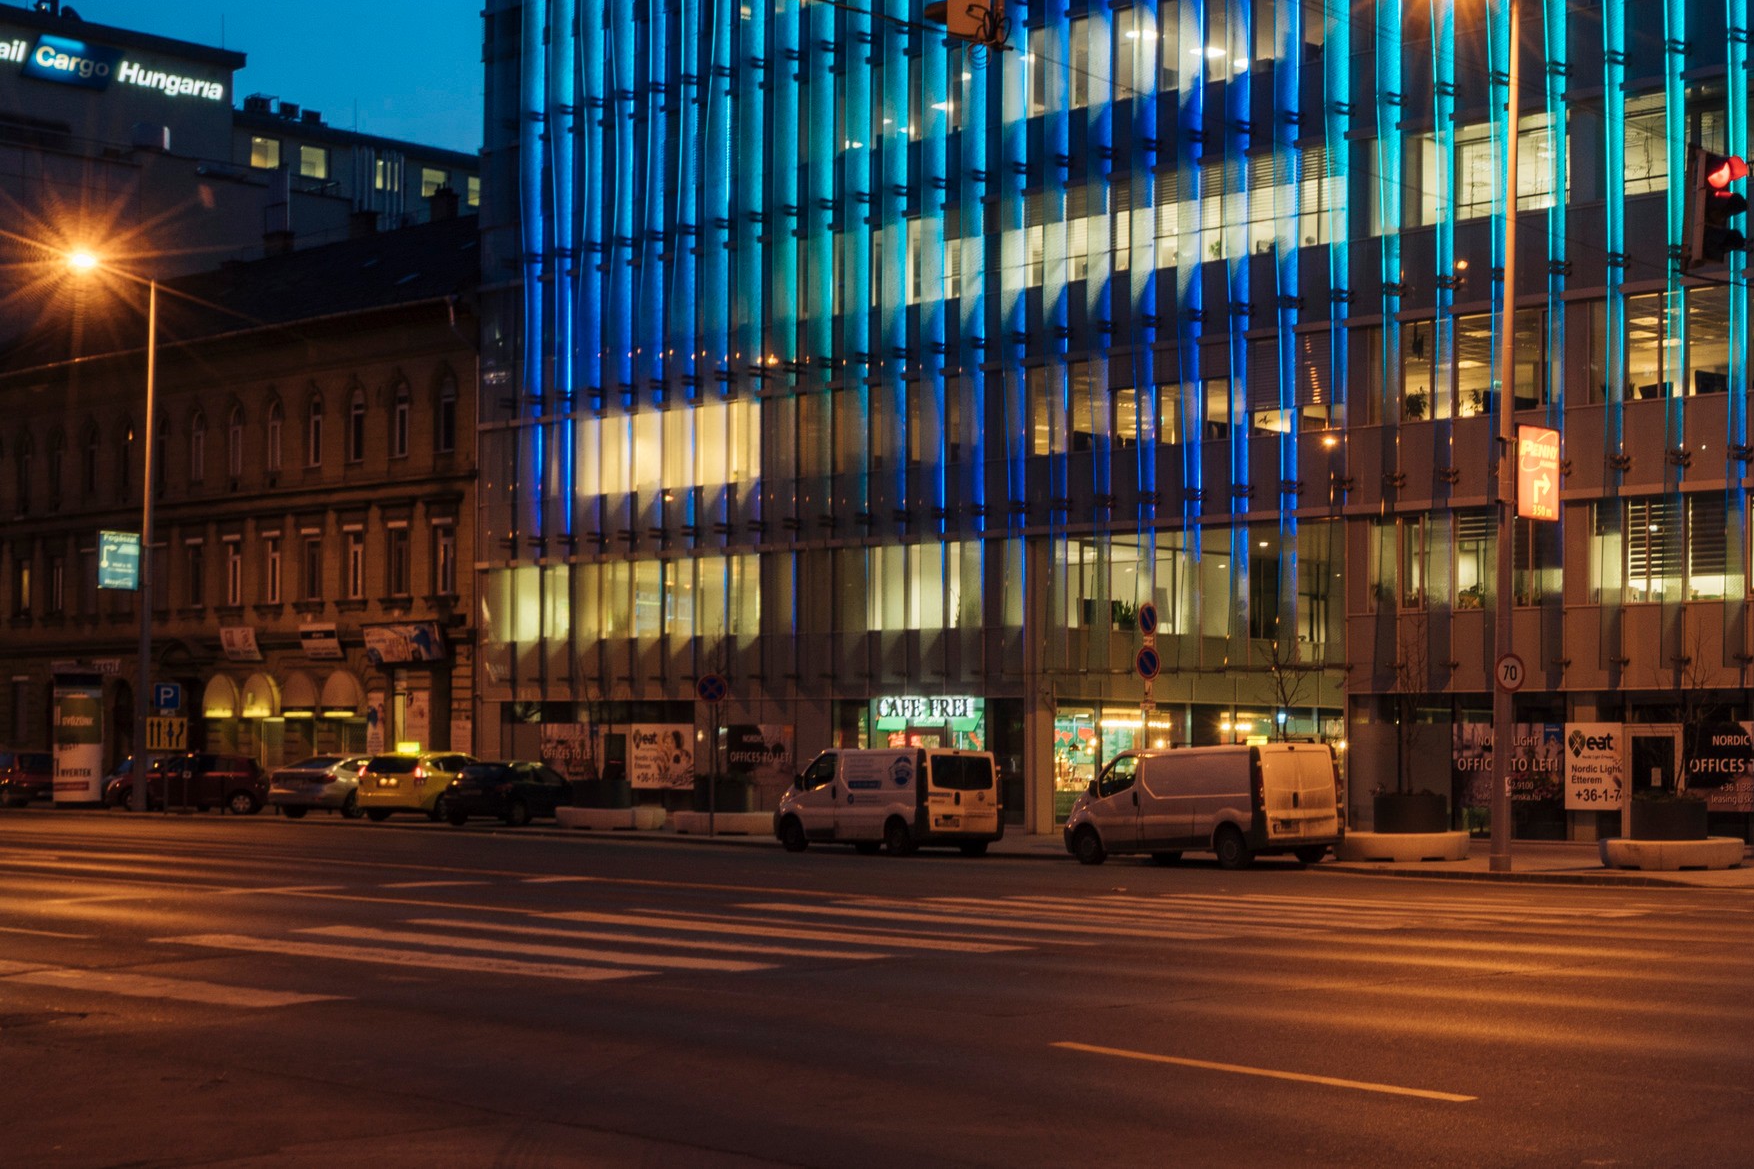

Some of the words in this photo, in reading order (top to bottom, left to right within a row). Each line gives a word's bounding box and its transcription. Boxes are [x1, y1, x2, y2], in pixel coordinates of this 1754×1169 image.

[35, 46, 110, 78] Cargo
[117, 60, 224, 100] Hungaria
[1519, 439, 1558, 460] PENNY
[1503, 665, 1517, 681] 70
[160, 687, 174, 705] P
[878, 698, 922, 718] CAFE
[929, 698, 968, 718] FREI
[1513, 736, 1539, 747] LIGHT
[1586, 733, 1614, 751] eat
[1712, 734, 1750, 746] NORDIC
[730, 751, 760, 763] OFFICES
[762, 751, 774, 763] TO
[1457, 757, 1494, 772] OFFIC
[1511, 757, 1528, 772] TO
[1532, 757, 1559, 772] LET!
[1571, 764, 1597, 773] Nordic
[1690, 758, 1745, 773] OFFICES
[1571, 772, 1602, 784] Étterem
[1575, 788, 1622, 802] +36-1-7
